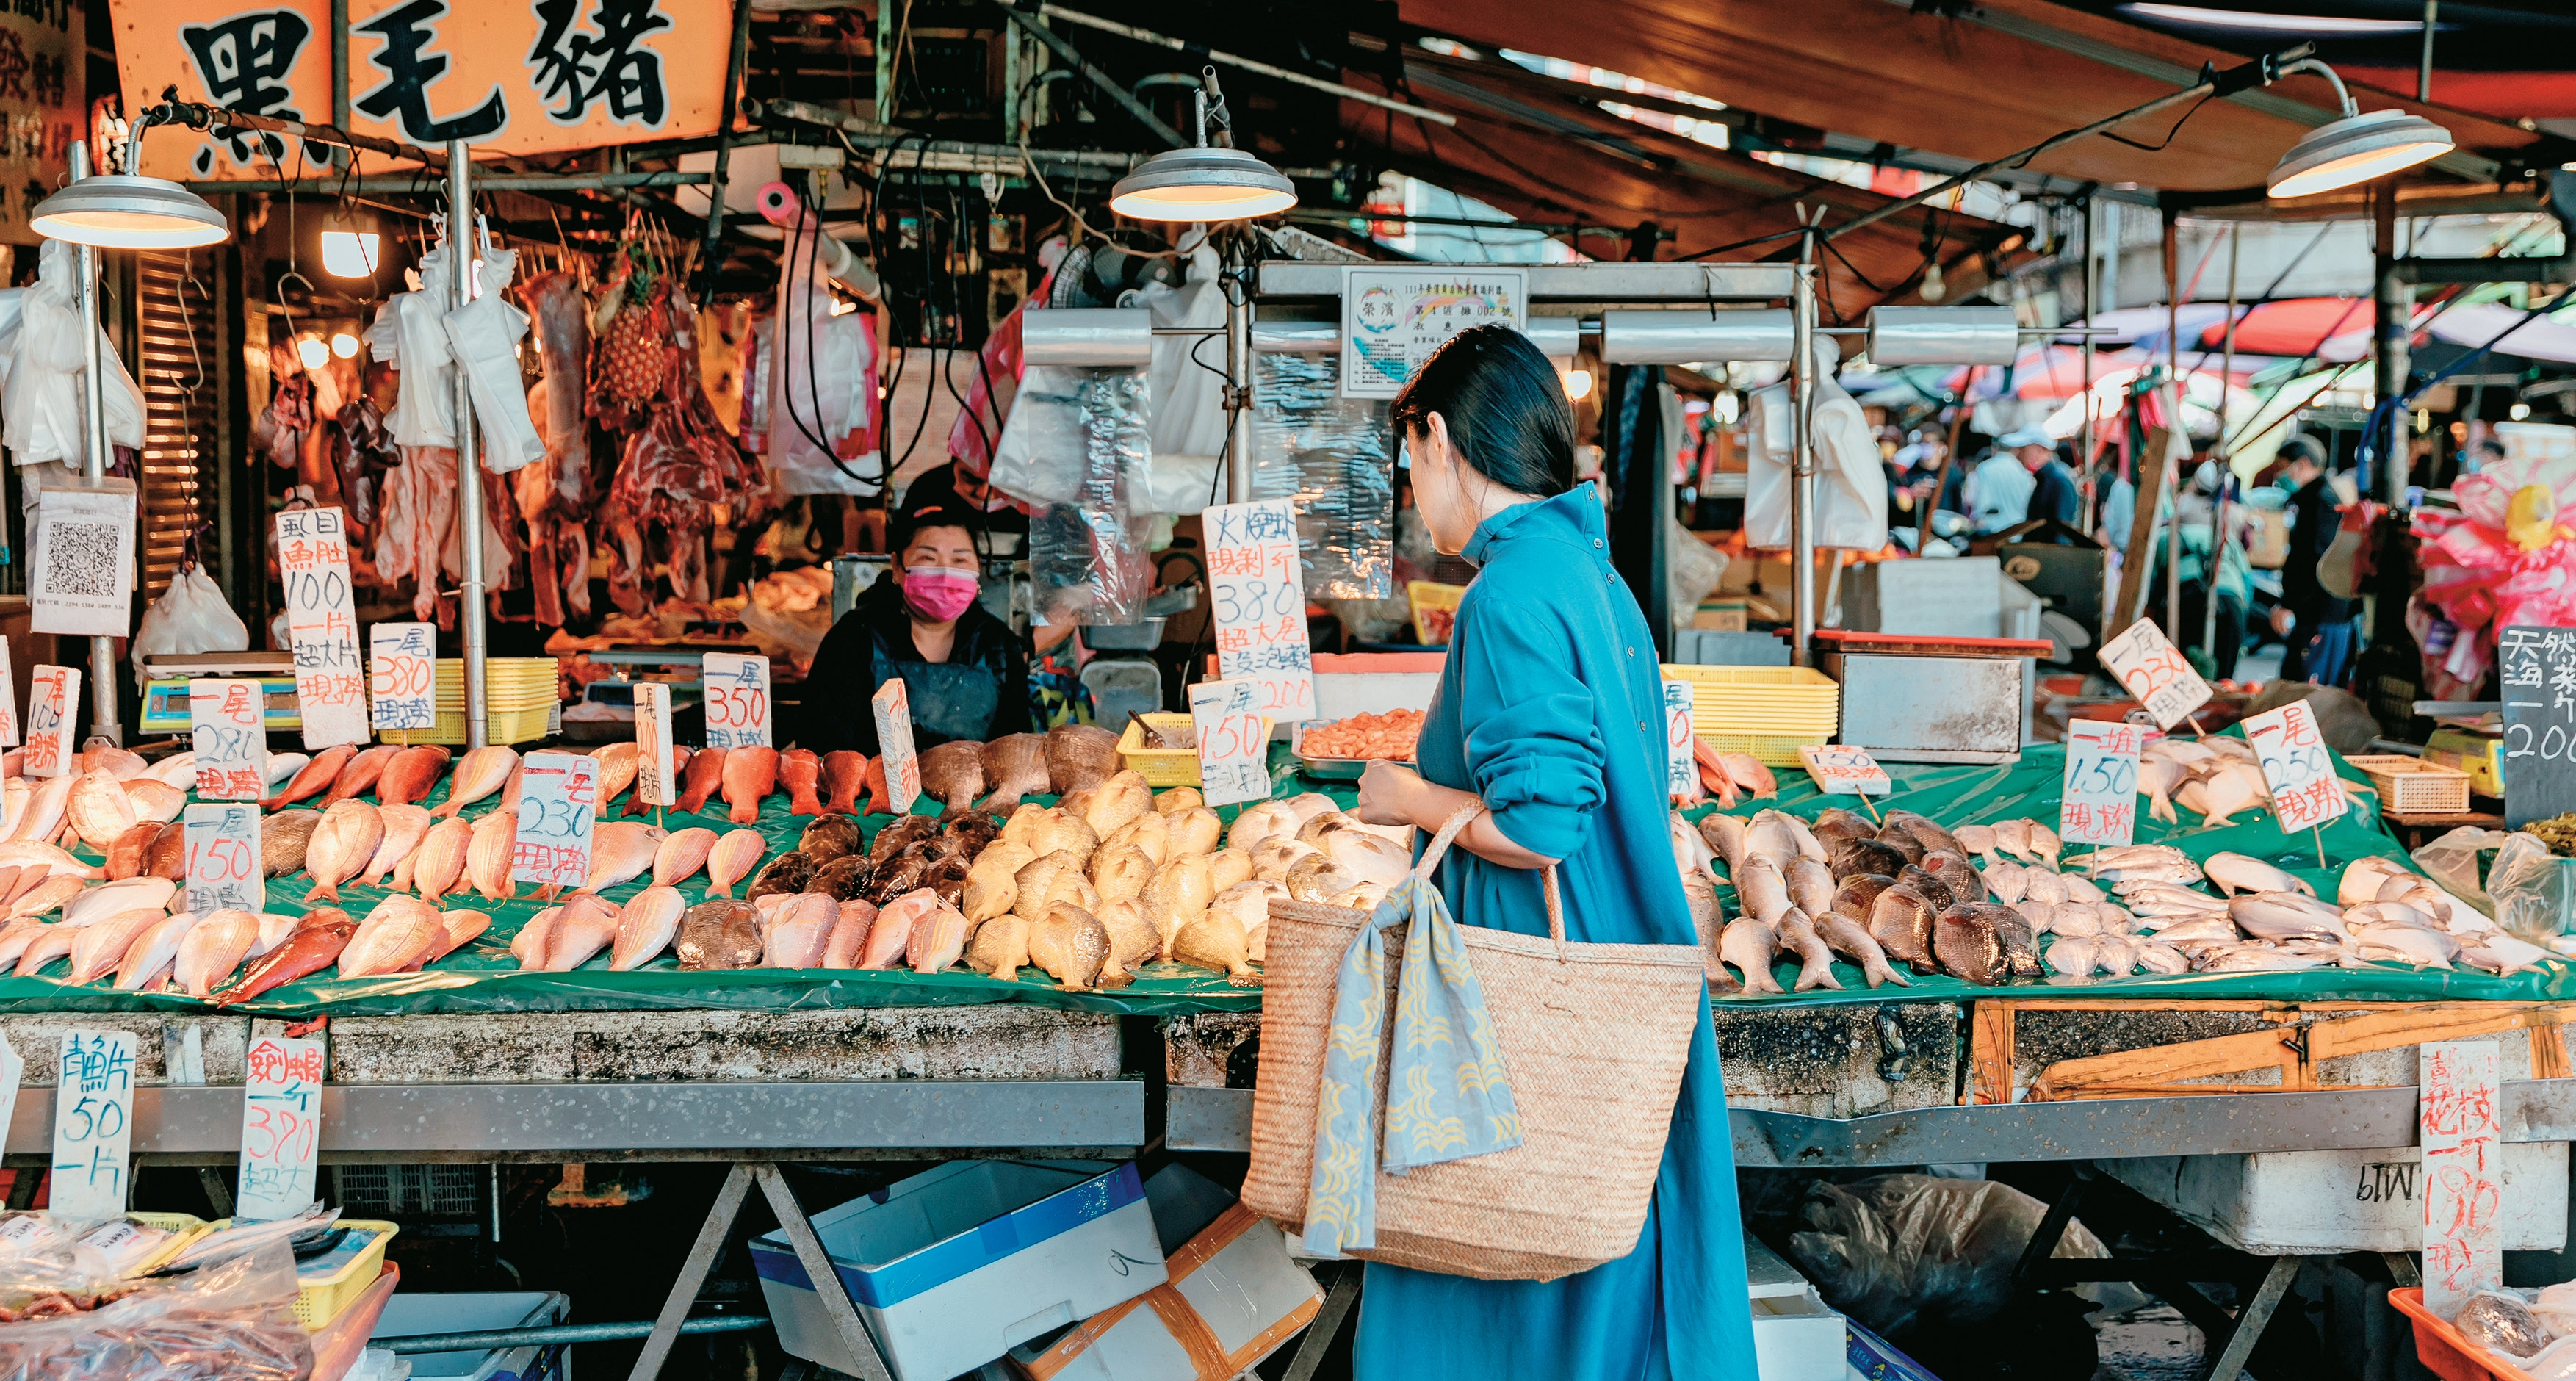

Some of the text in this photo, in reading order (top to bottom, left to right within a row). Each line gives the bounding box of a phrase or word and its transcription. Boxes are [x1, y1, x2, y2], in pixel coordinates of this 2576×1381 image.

[1363, 301, 1394, 317] 榮濱
[284, 539, 348, 571] 魚肚
[286, 571, 345, 610] 100
[1216, 580, 1297, 624] 380
[292, 611, 350, 641] 一片
[374, 628, 431, 657] 一尾
[1216, 616, 1305, 652] 超大尾
[2113, 624, 2165, 664] 一尾
[294, 638, 358, 668] 超大片
[2500, 629, 2576, 663] 天然
[34, 670, 66, 717] 一尾
[372, 656, 431, 696] 380
[705, 661, 764, 692] 一尾
[2125, 646, 2187, 703] 230
[2503, 654, 2576, 695] 海菜
[30, 702, 60, 729] 100
[190, 684, 258, 726] 一尾
[635, 686, 656, 720] 一尾
[708, 687, 765, 728] 350
[1194, 682, 1260, 716] 一尾
[2508, 691, 2575, 724] 一斤
[194, 724, 259, 763] 280
[1201, 713, 1261, 760] 150
[2073, 726, 2137, 756] 一堆
[2250, 707, 2318, 748] 一尾
[1814, 754, 1871, 766] 150
[2263, 746, 2326, 793] 250
[524, 760, 594, 804] 一尾
[188, 808, 252, 838] 一尾
[518, 796, 592, 837] 230
[188, 837, 253, 883] 150
[248, 1081, 315, 1111] 一斤
[2420, 1083, 2501, 1136] 花枝
[62, 1096, 123, 1142] 50
[54, 1145, 120, 1197] 一片
[242, 1161, 312, 1202] 超大
[2356, 1164, 2422, 1203] M19
